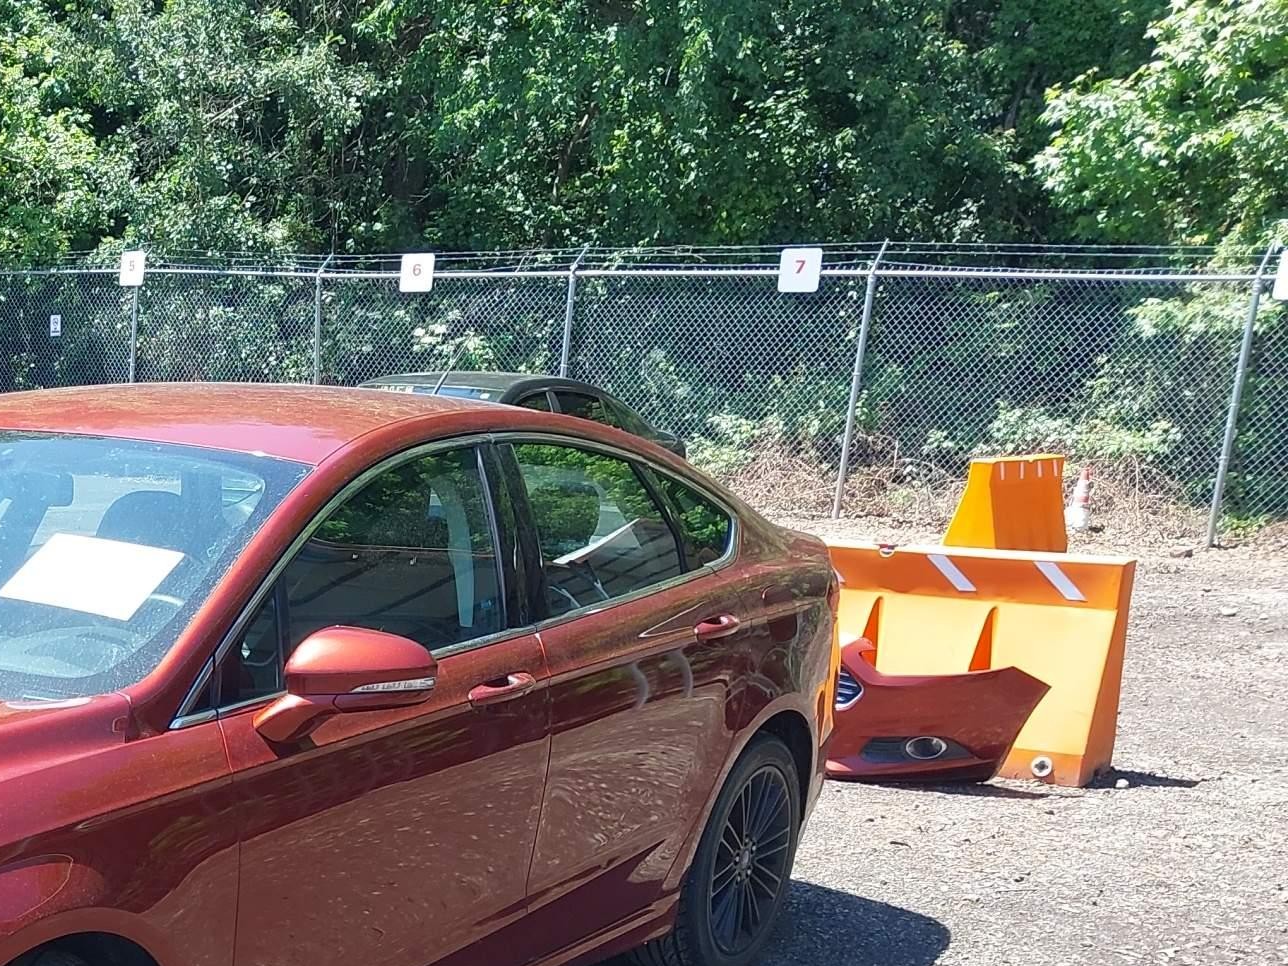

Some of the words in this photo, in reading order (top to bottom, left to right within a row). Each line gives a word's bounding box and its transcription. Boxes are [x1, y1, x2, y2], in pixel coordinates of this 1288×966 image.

[129, 260, 135, 272] 5
[412, 264, 422, 276] 6
[795, 260, 806, 274] 7
